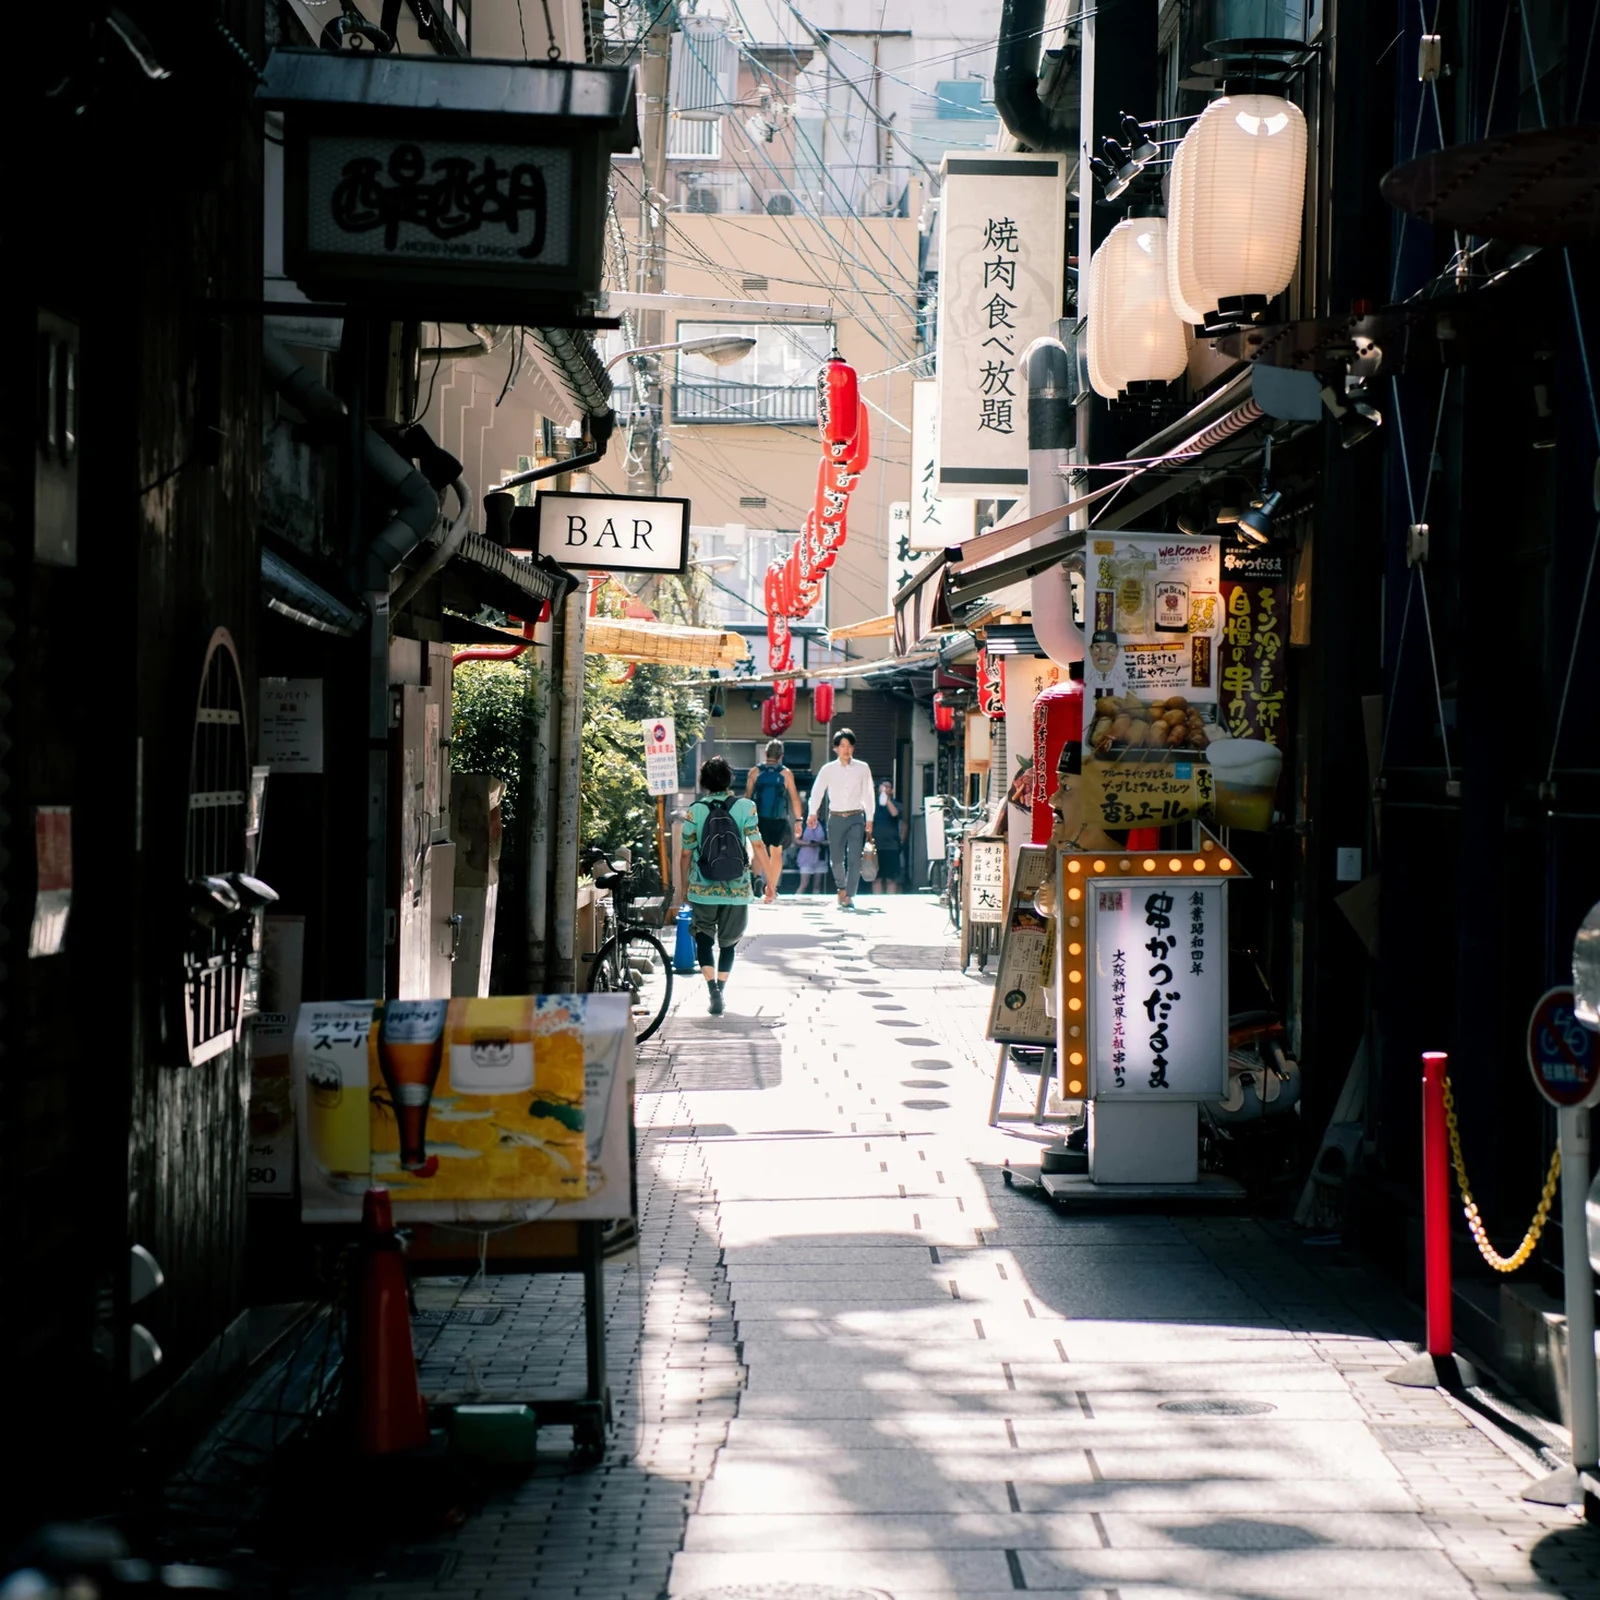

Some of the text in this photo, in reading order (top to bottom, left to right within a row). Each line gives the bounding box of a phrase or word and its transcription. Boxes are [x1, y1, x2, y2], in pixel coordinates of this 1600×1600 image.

[477, 244, 516, 257] DAIGO
[977, 215, 1019, 435] 焼肉食べ放題
[564, 515, 654, 552] BAR
[1158, 544, 1212, 557] Welcome!
[1224, 554, 1282, 571] 串かつだるま
[1157, 585, 1186, 598] JIM BEAM
[1223, 585, 1255, 738] 自慢の串カツ
[1250, 587, 1285, 745] キン冷えの一杯と
[266, 691, 310, 700] アルバイト
[1100, 793, 1190, 823] 香るエール
[974, 848, 982, 881] 一品料理
[1188, 891, 1205, 976] 創業昭和四年
[1143, 891, 1181, 1089] 串かつだるま
[1111, 949, 1128, 1088] 大阪新世界元祖串かつ
